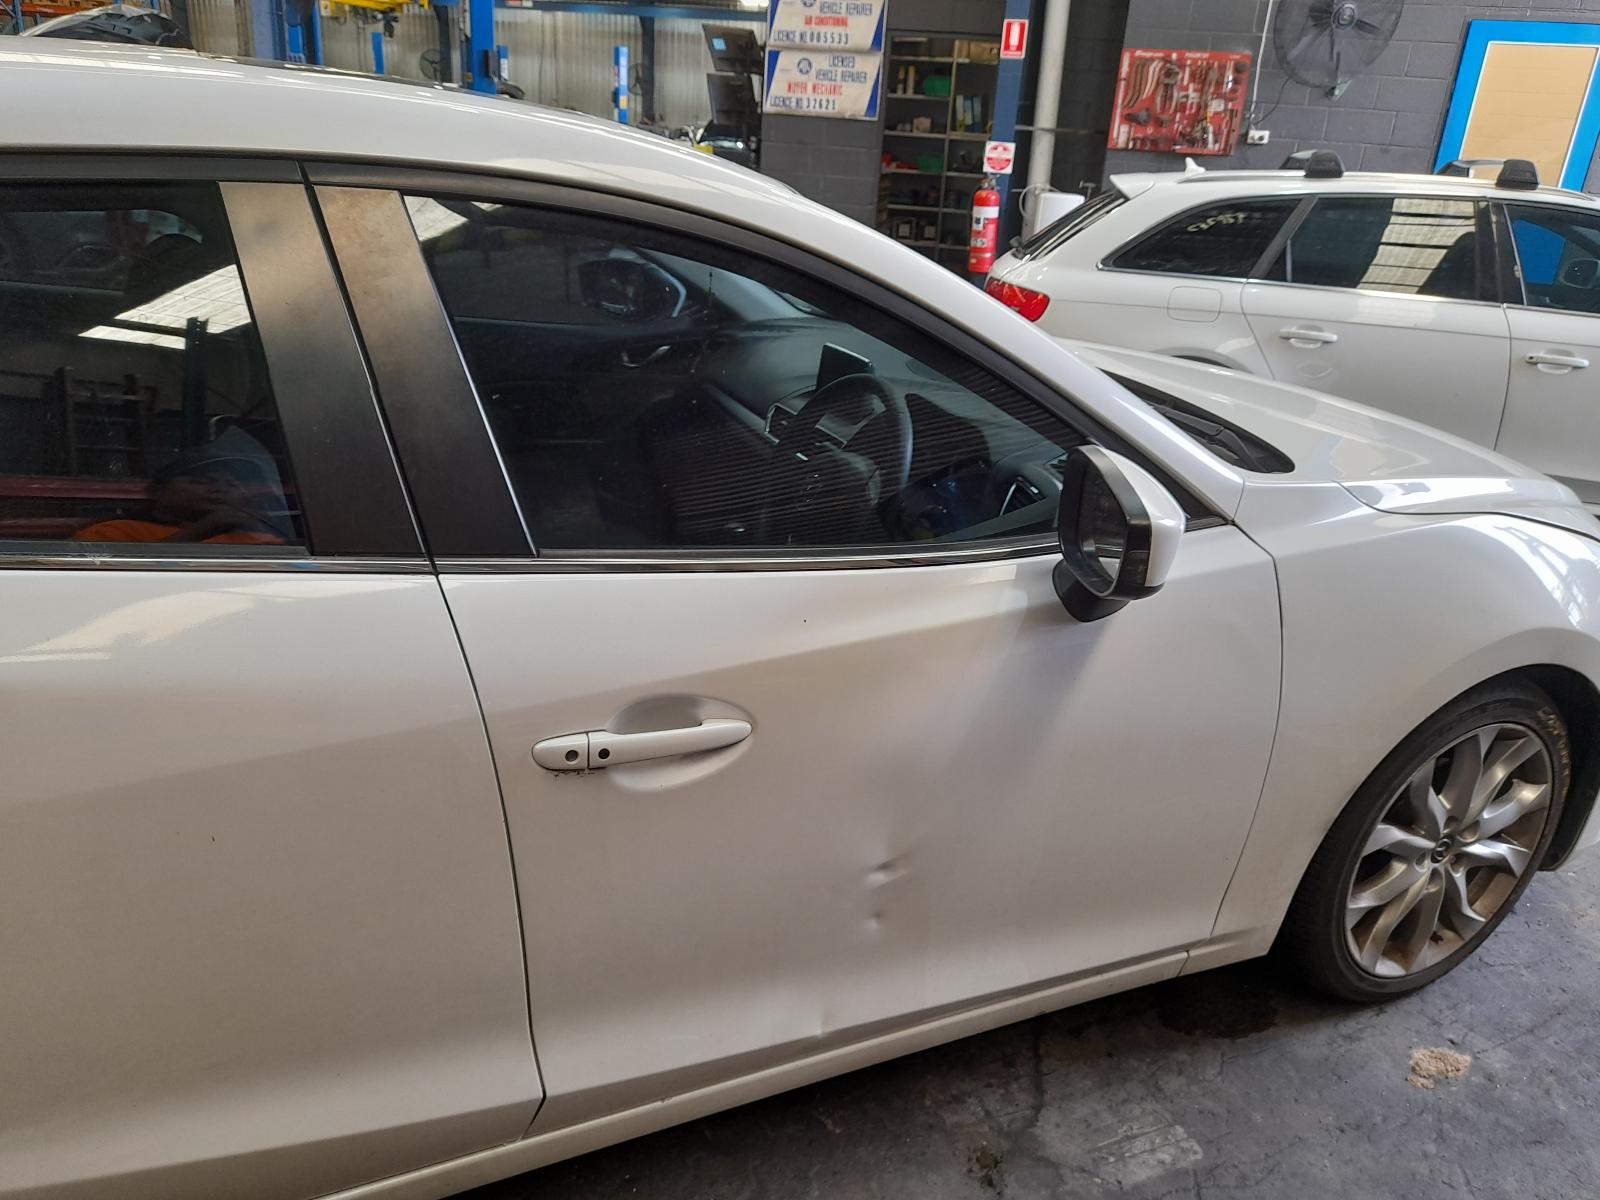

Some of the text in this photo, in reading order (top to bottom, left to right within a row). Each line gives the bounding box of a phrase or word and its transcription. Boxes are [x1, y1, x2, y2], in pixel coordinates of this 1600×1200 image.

[816, 69, 867, 83] VEHICLE REPAIRER
[787, 81, 843, 95] MOTOR MECHANIC
